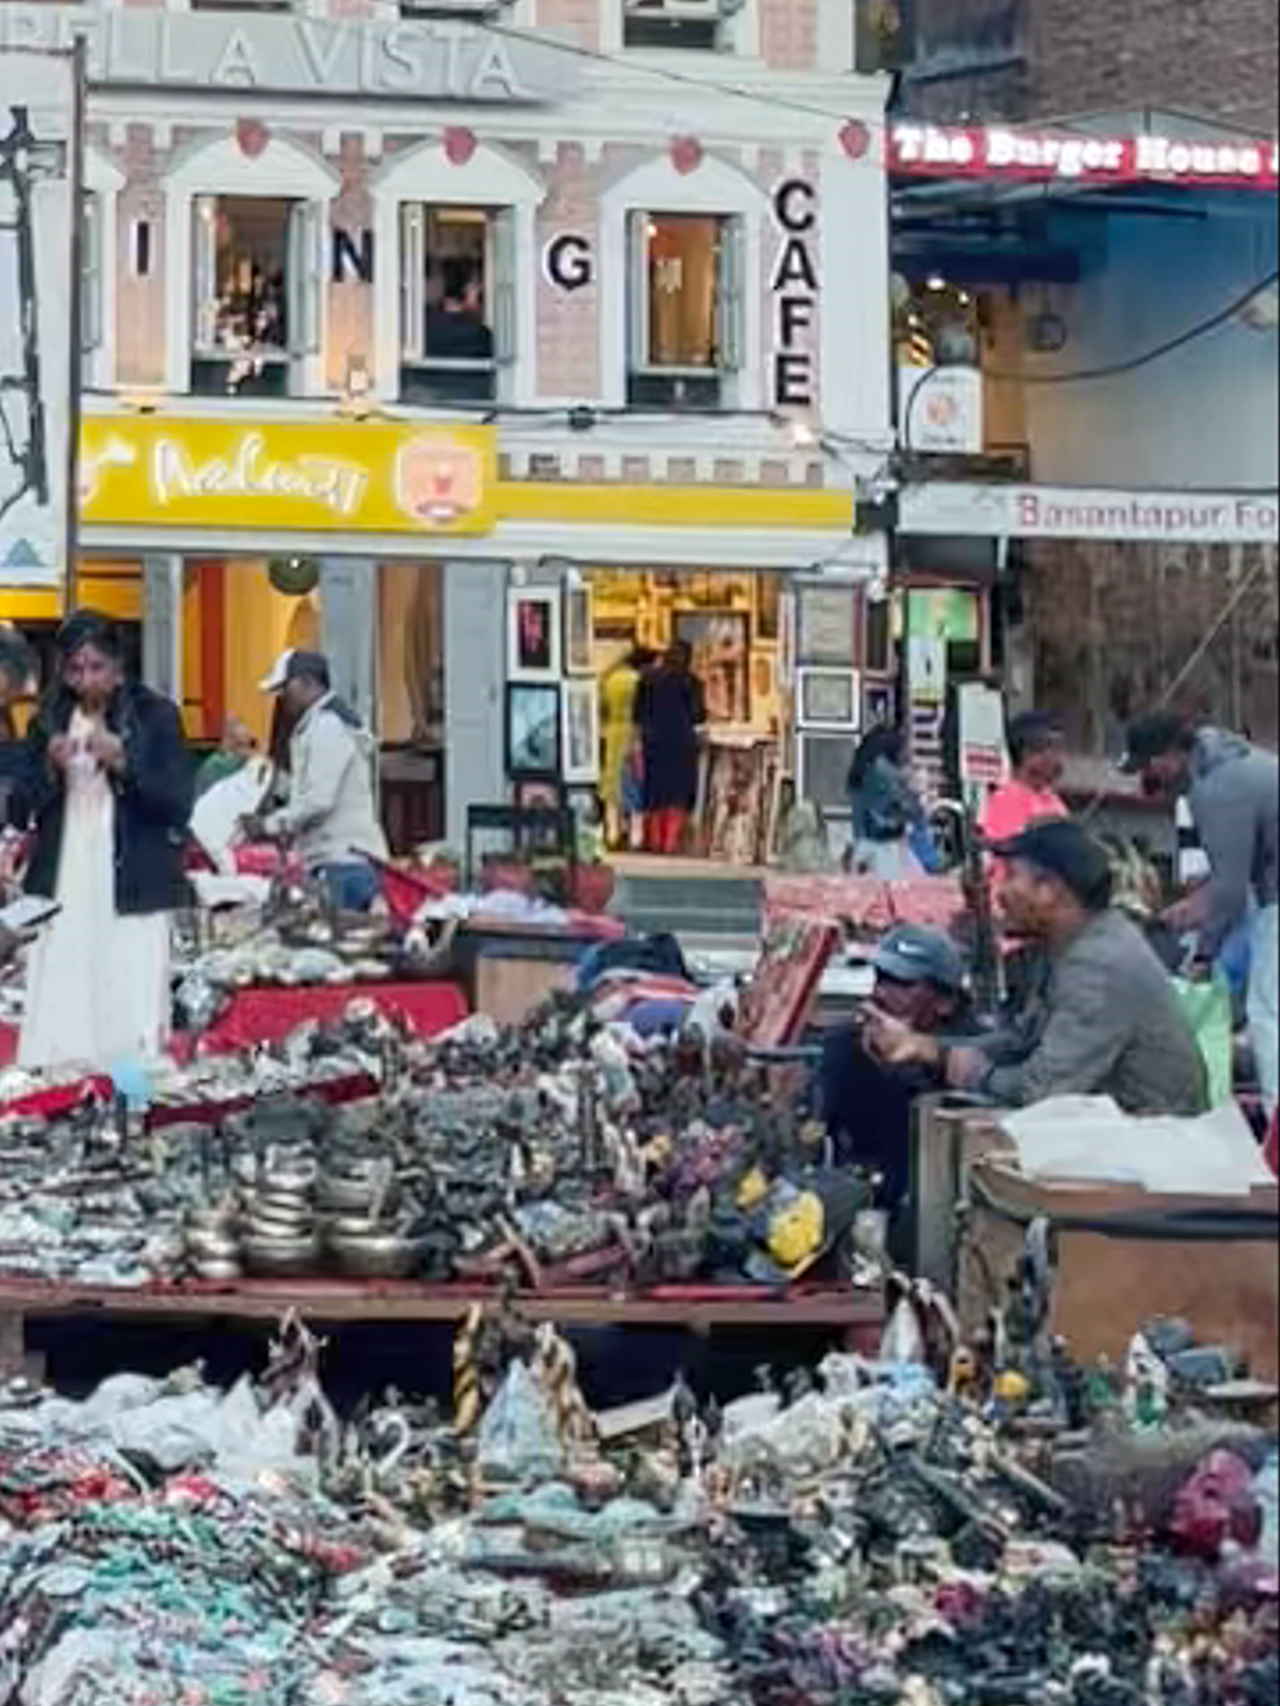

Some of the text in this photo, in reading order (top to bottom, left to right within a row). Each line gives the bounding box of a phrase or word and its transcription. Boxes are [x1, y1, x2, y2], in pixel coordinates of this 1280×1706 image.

[296, 20, 522, 98] VISTA
[893, 126, 974, 165] The
[985, 129, 1124, 176] Burger
[1136, 134, 1260, 175] House
[772, 180, 820, 408] CAFE
[1018, 492, 1226, 532] Basantapur
